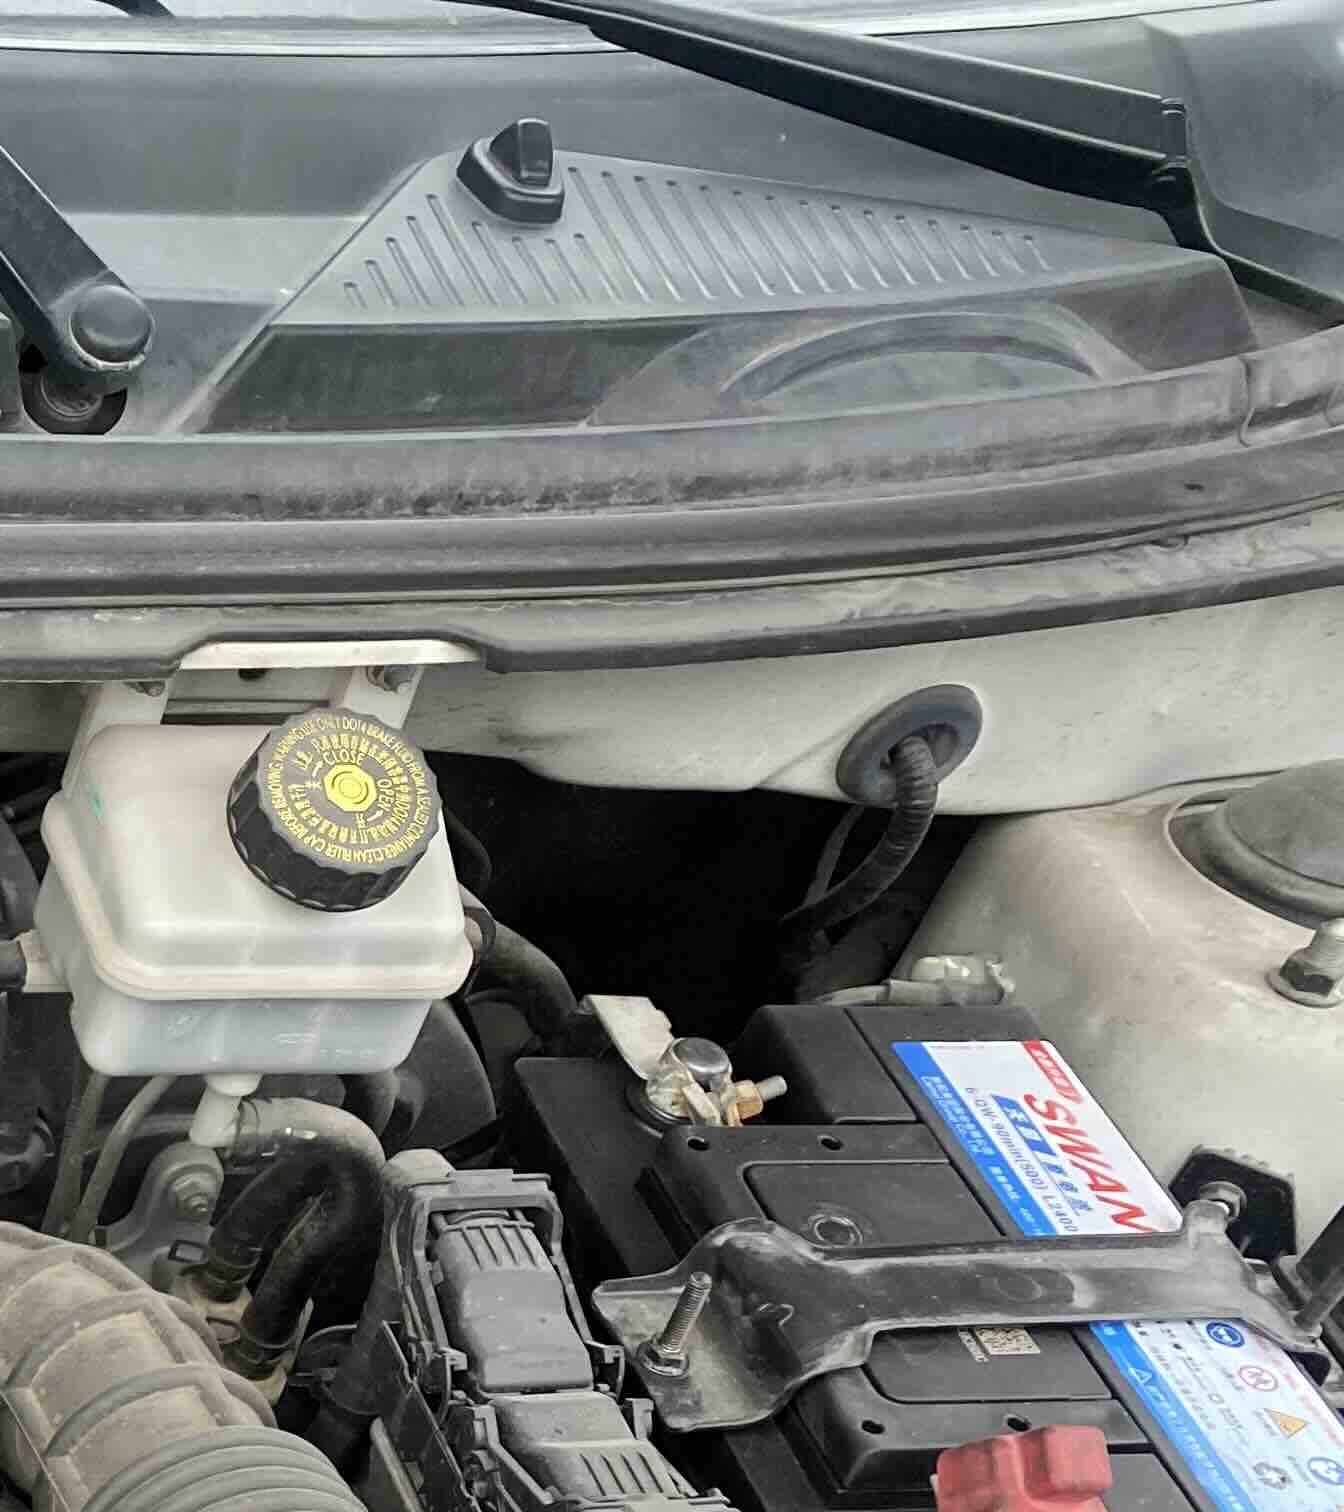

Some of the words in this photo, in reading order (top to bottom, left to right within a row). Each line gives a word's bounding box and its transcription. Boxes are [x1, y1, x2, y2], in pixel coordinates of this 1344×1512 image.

[323, 749, 366, 766] CLOSE
[375, 778, 394, 813] OPEN
[1023, 1093, 1159, 1233] SWAN
